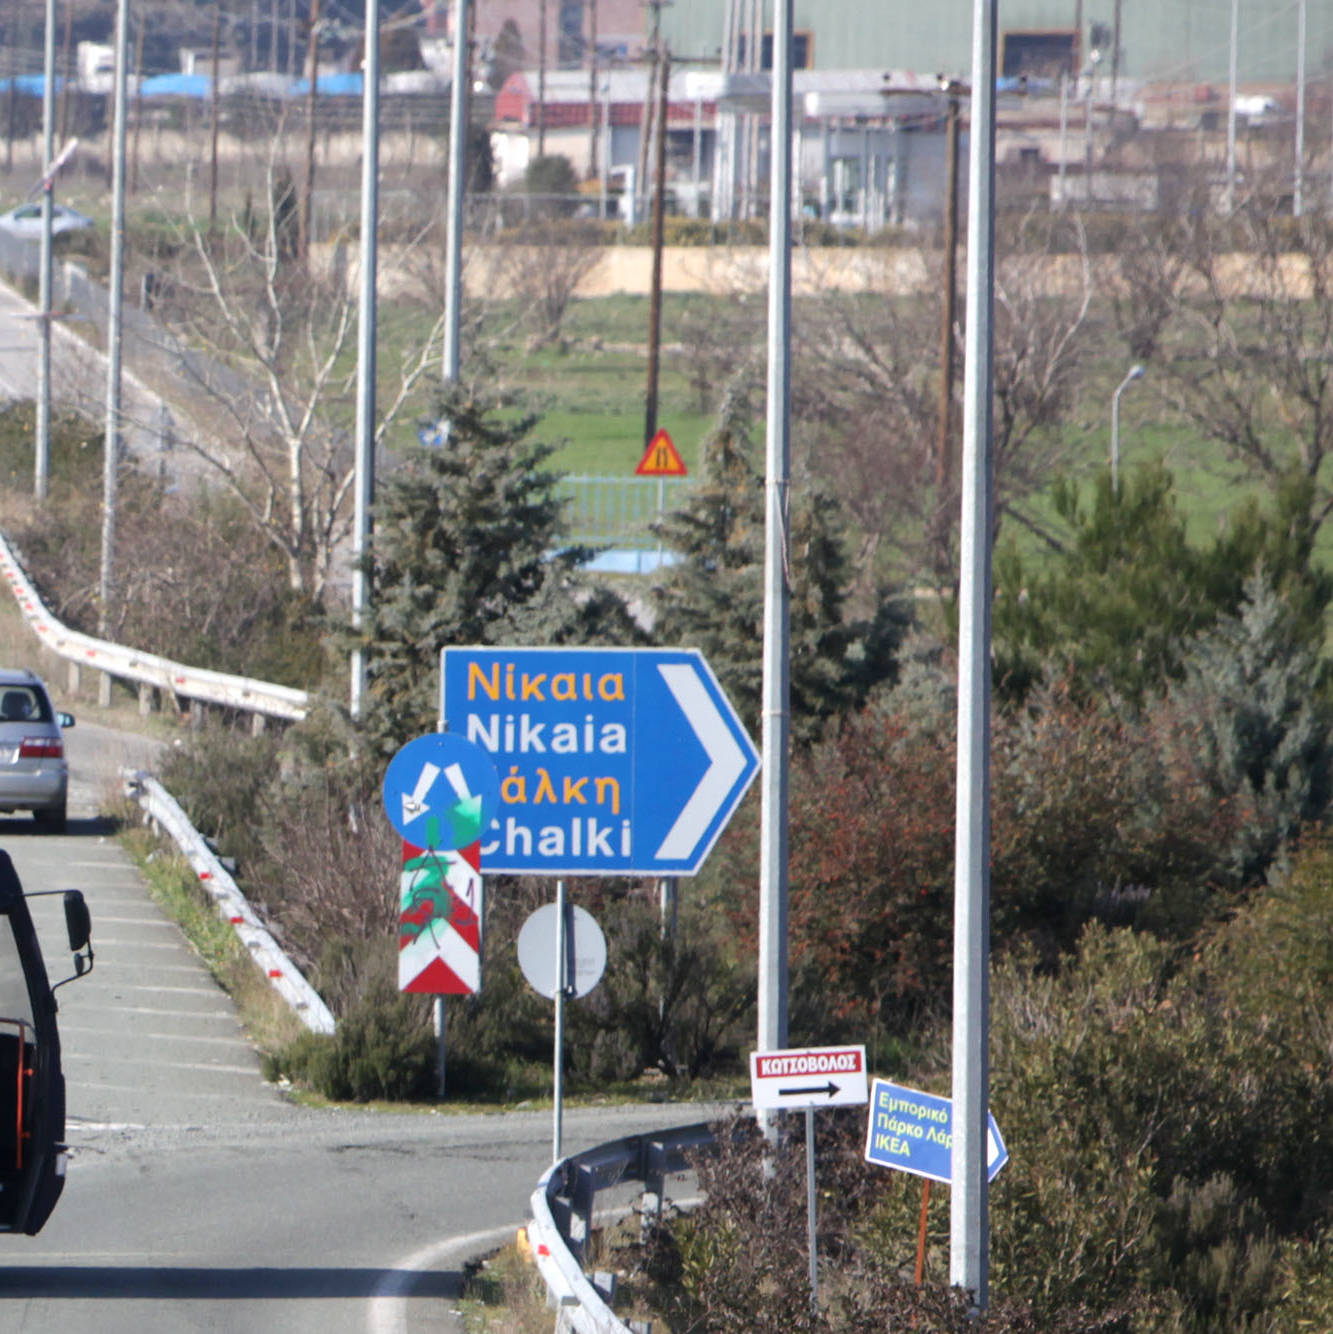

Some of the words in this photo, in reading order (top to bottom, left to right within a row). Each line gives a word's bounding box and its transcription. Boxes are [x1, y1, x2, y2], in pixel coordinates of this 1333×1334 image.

[467, 661, 626, 702] Νίκαια
[466, 713, 627, 754] Nikaia
[500, 765, 621, 815] άλκη
[761, 1053, 857, 1076] ΚΩΤΣΟΒΟΛΟΣ
[878, 1091, 949, 1124] Εμπορικό
[876, 1112, 925, 1139] Πάρκο
[874, 1133, 911, 1157] IKEA
